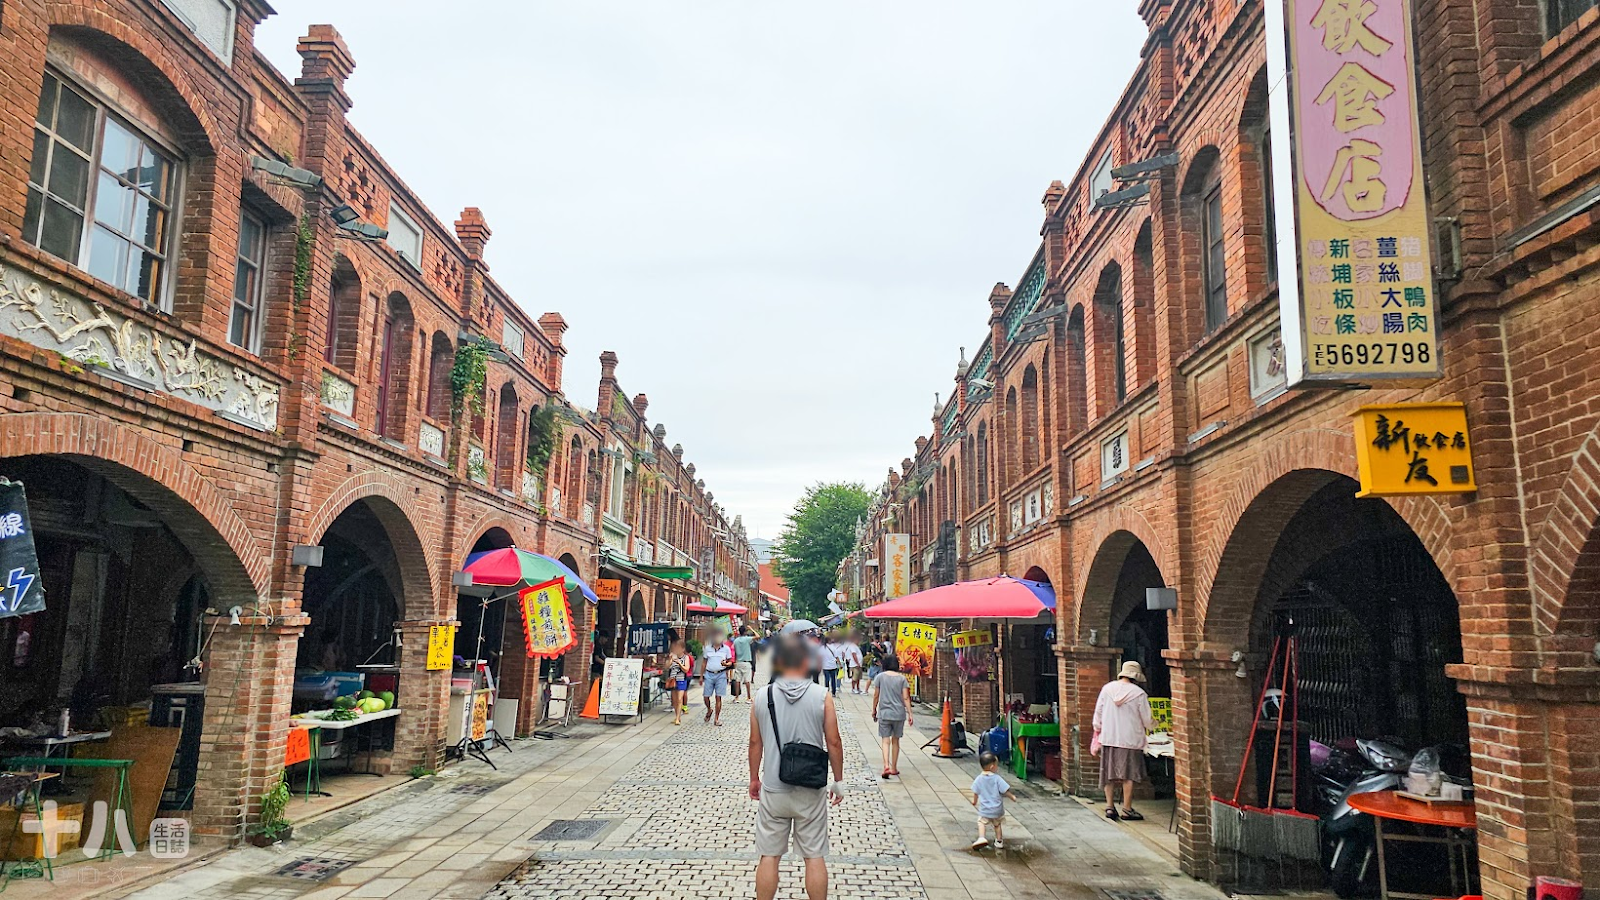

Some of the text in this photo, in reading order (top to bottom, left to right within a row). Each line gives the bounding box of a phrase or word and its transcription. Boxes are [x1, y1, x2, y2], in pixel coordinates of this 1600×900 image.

[1309, 0, 1396, 213] 飲食店
[1329, 238, 1356, 335] 新埔板條
[1376, 237, 1404, 334] 薑絲大腸
[1313, 342, 1430, 366] TEL 5692798
[892, 553, 904, 597] 客家菜
